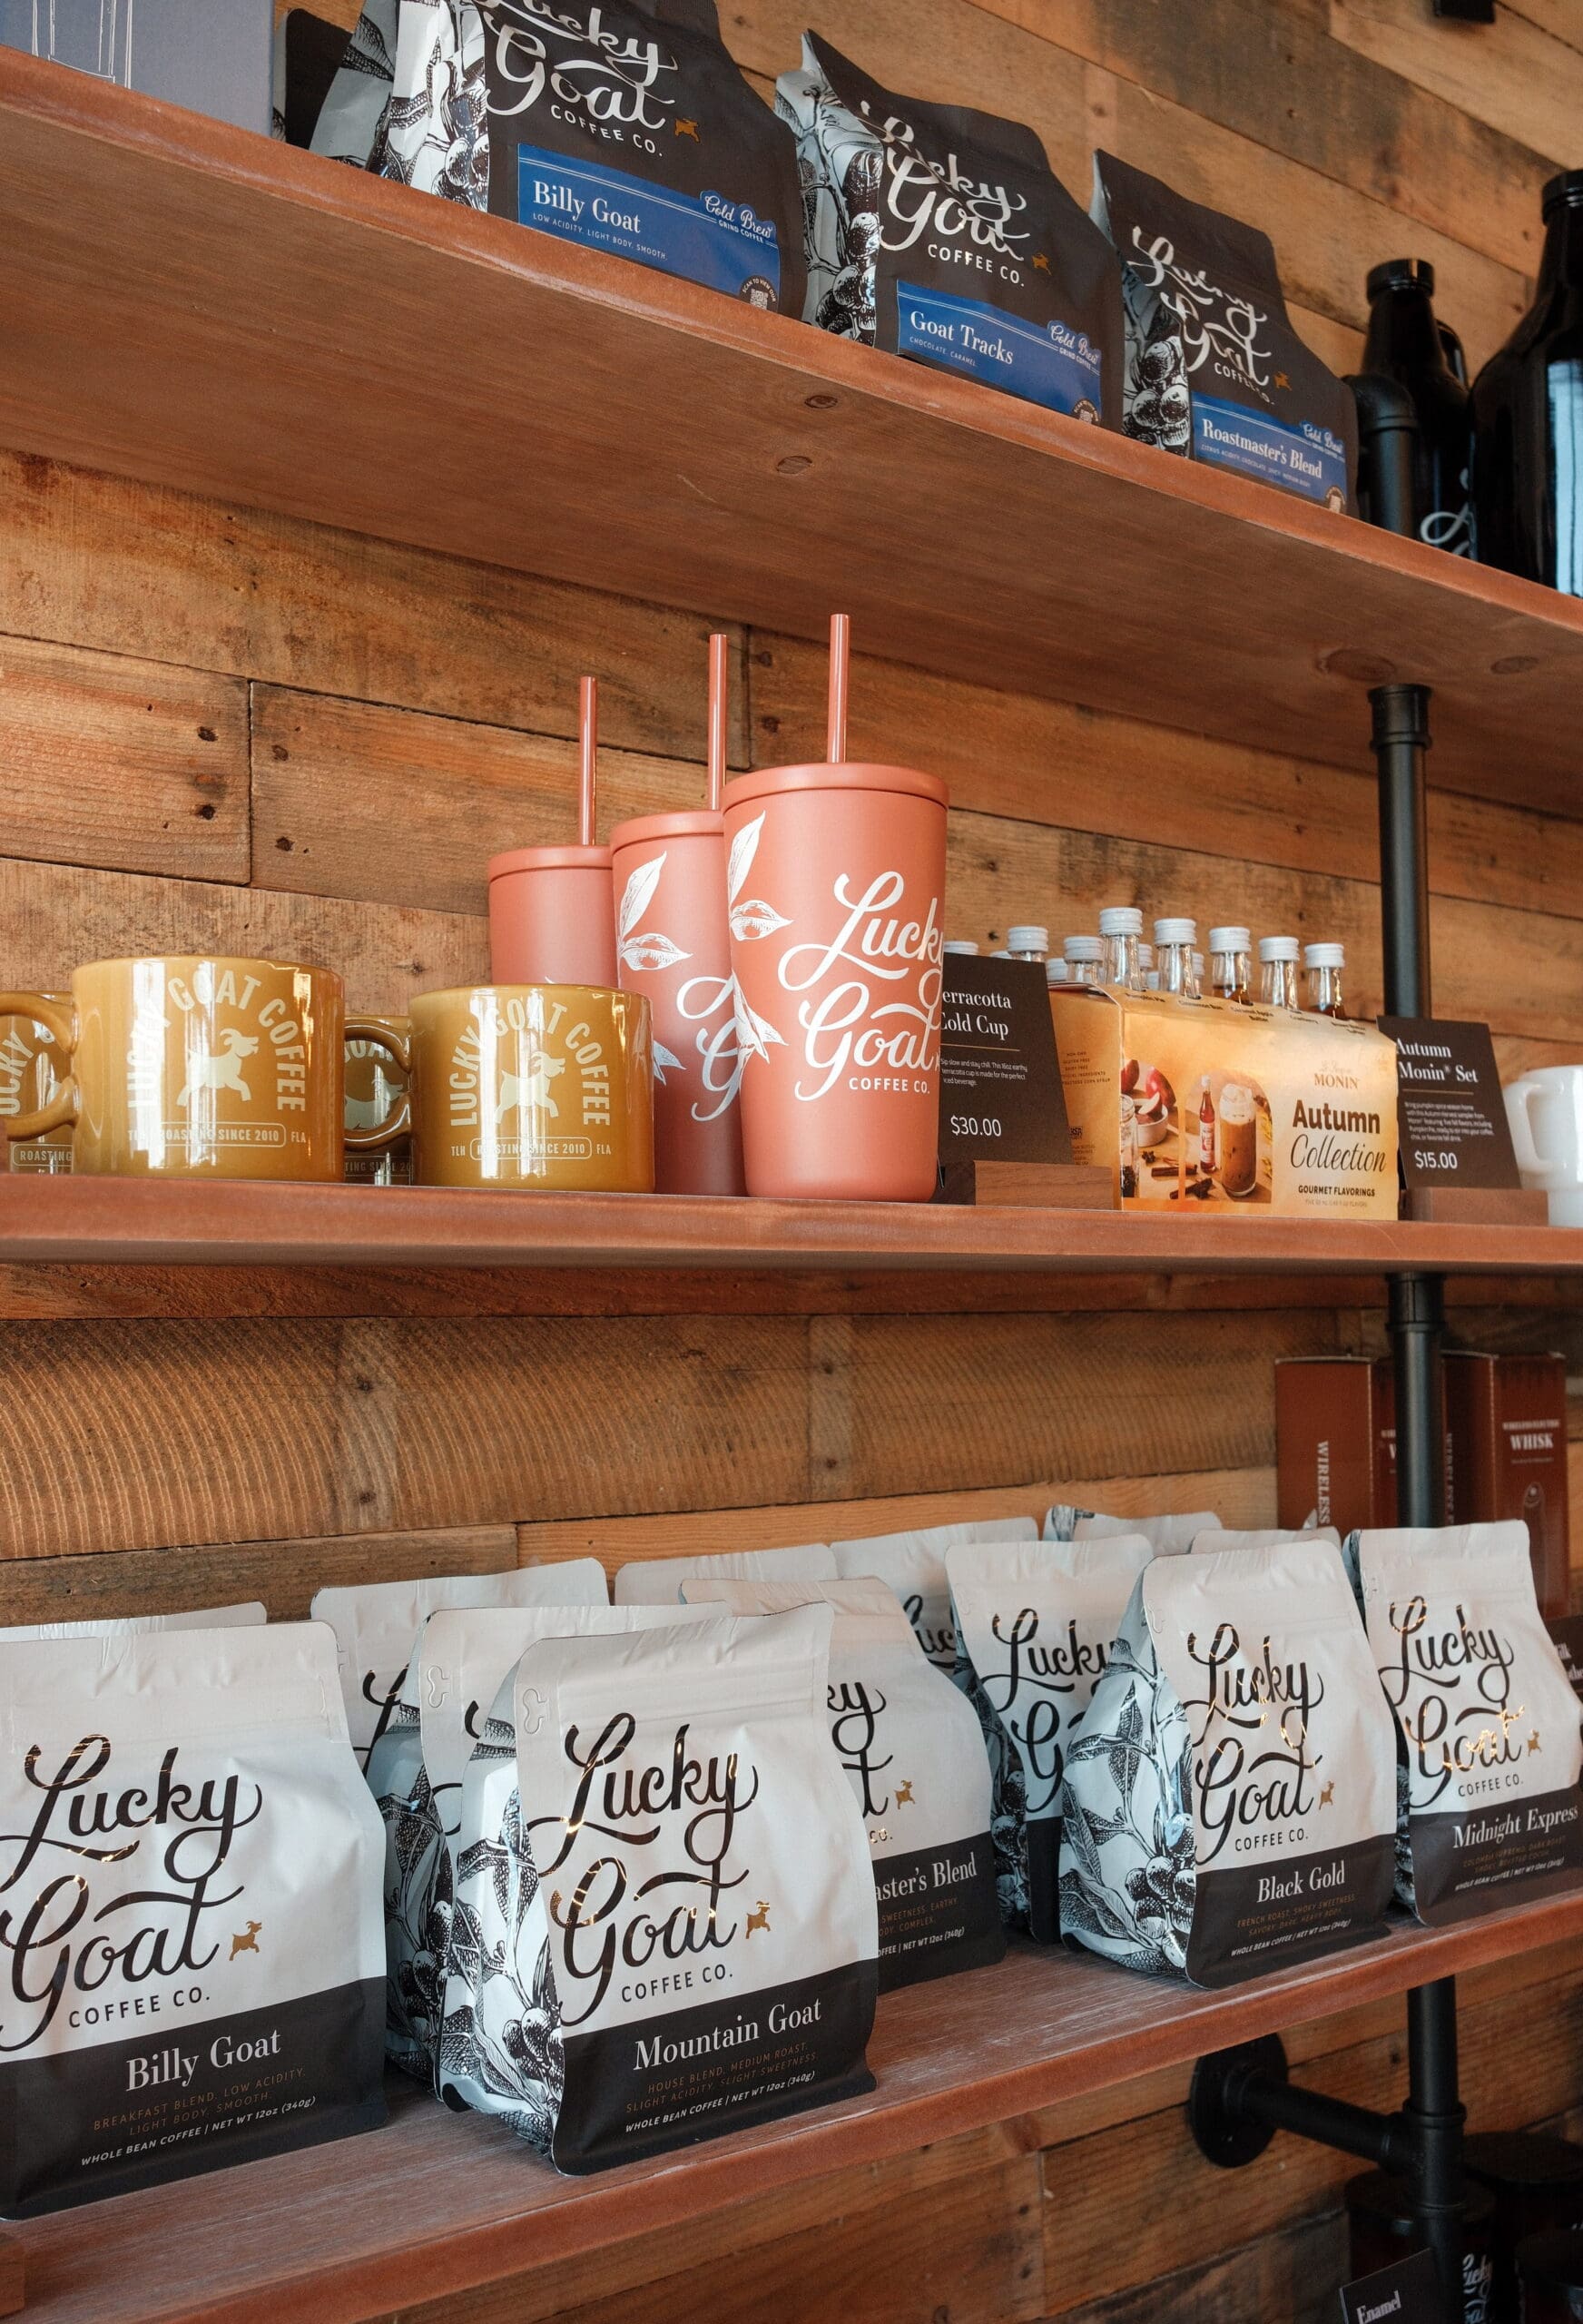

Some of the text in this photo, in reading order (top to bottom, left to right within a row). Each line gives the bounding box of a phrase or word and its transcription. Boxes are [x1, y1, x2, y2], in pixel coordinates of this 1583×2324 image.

[473, 0, 679, 86] ucky
[482, 12, 675, 129] Goat
[550, 104, 663, 157] COFFEE CO.
[533, 181, 641, 234] Billy Goat
[533, 212, 550, 223] LOW
[587, 231, 610, 242] LIGHT
[704, 195, 773, 239] Cold Brew
[718, 219, 740, 233] GRIND
[928, 243, 1025, 288] COFFEE CO.
[910, 310, 1014, 365] Goat Tracks
[1050, 325, 1075, 349] Cold
[1202, 419, 1287, 465] Roastmaster's
[1290, 448, 1322, 479] Blend
[942, 990, 1012, 1009] erracotta
[168, 970, 261, 1011] GOAT
[258, 999, 307, 1112] COFFEE
[794, 981, 941, 1101] Goat
[976, 1014, 1008, 1041] Cup
[1397, 1038, 1452, 1058] Autumn
[0, 1030, 34, 1115] UCKY
[450, 1025, 487, 1127] LUCKY
[485, 999, 567, 1038] GOAT
[565, 1022, 610, 1126] COFFEE
[1455, 1065, 1479, 1083] Set
[849, 1078, 930, 1095] COFFEE CO.
[217, 1129, 252, 1141] SINCE
[254, 1129, 280, 1142] 2010
[290, 1131, 307, 1144] FLA
[950, 1115, 1002, 1137] $30.00
[1292, 1099, 1381, 1135] Autumn
[451, 1146, 466, 1157] TLH
[562, 1143, 585, 1155] 2010
[595, 1144, 612, 1156] FLA
[1290, 1133, 1387, 1173] Collection
[1414, 1150, 1458, 1170] $15.00
[1298, 1185, 1375, 1197] GOURMET FLAVORINGS
[1509, 1433, 1554, 1451] WHISK
[1318, 1440, 1331, 1525] WIRELESS
[1379, 1595, 1514, 1707] Lucky
[1183, 1623, 1324, 1749] Lucky
[1406, 1695, 1525, 1808] Goat
[526, 1712, 759, 1876] Lucky
[1195, 1737, 1323, 1866] Goat
[1458, 1774, 1524, 1797] COFFEE CO.
[0, 1734, 262, 1893] Lucky
[1452, 1806, 1578, 1848] Midnight Express
[1235, 1828, 1308, 1852] COFFEE CO.
[875, 1851, 978, 1901] aster's Blend
[1256, 1860, 1345, 1903] Black Gold
[550, 1856, 750, 2026] Goat
[879, 1925, 897, 1937] ODY.
[1237, 1915, 1264, 1928] FRENCH
[0, 1875, 244, 2052] Goat
[878, 1945, 897, 1957] OFFEE
[903, 1940, 916, 1951] NET
[918, 1937, 928, 1947] WT
[929, 1935, 943, 1944] 12oz
[1231, 1945, 1253, 1957] WHOLE
[1254, 1941, 1271, 1951] BEAN
[1271, 1934, 1292, 1946] COFFEE
[1296, 1930, 1308, 1938] NET
[622, 1964, 733, 2003] COFFEE CO.
[69, 1986, 211, 2028] COFFEE CO.
[633, 1998, 821, 2071] Mountain Goat
[126, 2029, 281, 2092] Billy Goat
[648, 2076, 685, 2094] HOUSE
[731, 2052, 771, 2072] MEDIUM
[93, 2103, 168, 2132] BREAKFAST
[224, 2083, 250, 2097] LOW
[625, 2071, 815, 2132] WHOLE BEAN COFFEE NET WT 12oz (340g)
[626, 2094, 666, 2113] SLIGHT
[721, 2069, 756, 2086] SLIGHT
[81, 2095, 317, 2166] WHOLE BEAN COFFEE NET WT 12oz (340g)
[130, 2118, 167, 2136] LIGHT
